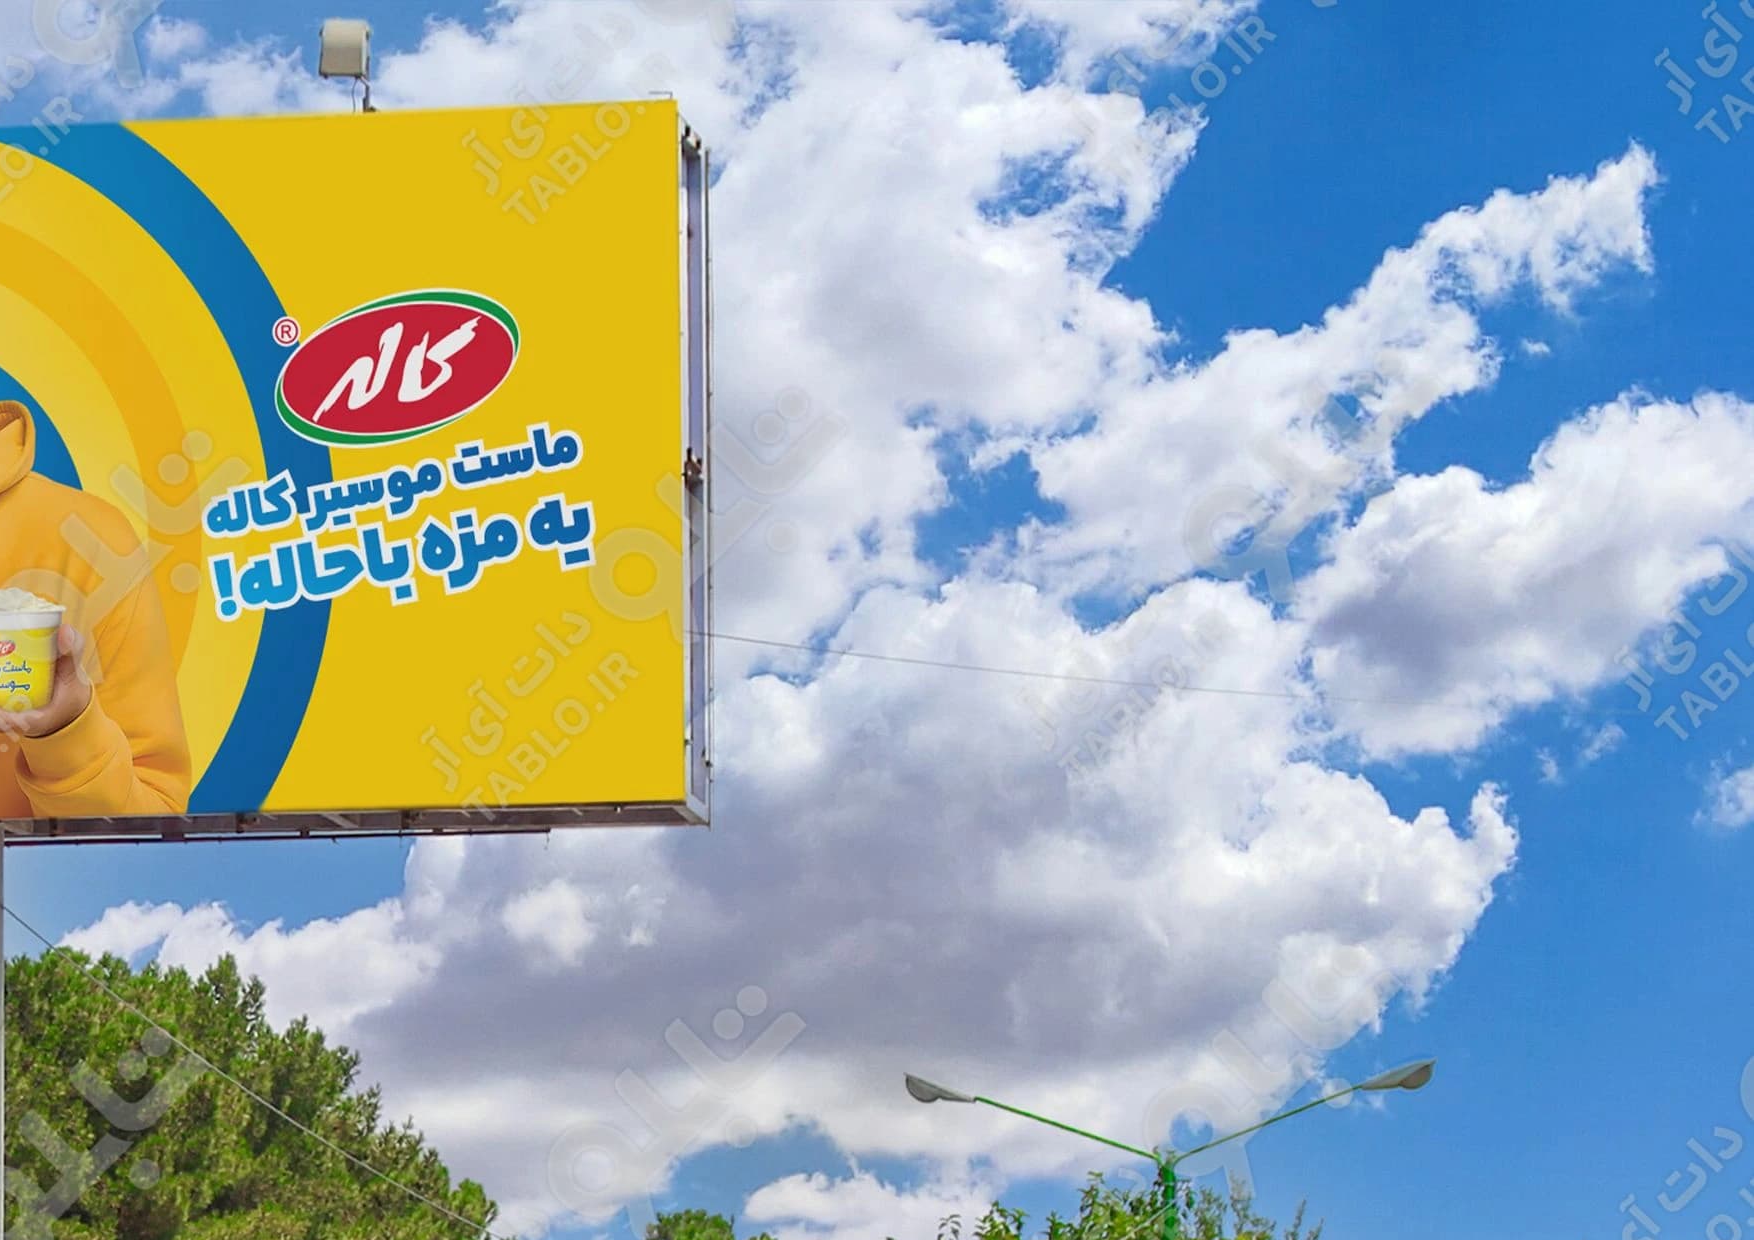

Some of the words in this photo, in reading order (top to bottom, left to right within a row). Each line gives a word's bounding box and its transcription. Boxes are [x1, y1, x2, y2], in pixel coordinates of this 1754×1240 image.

[312, 315, 483, 424] کاله
[452, 427, 579, 485] ماست
[205, 474, 290, 533] کاله
[305, 463, 442, 530] موسیر
[420, 514, 519, 590] مزه
[529, 498, 592, 567] یه
[2, 660, 32, 674] ماست
